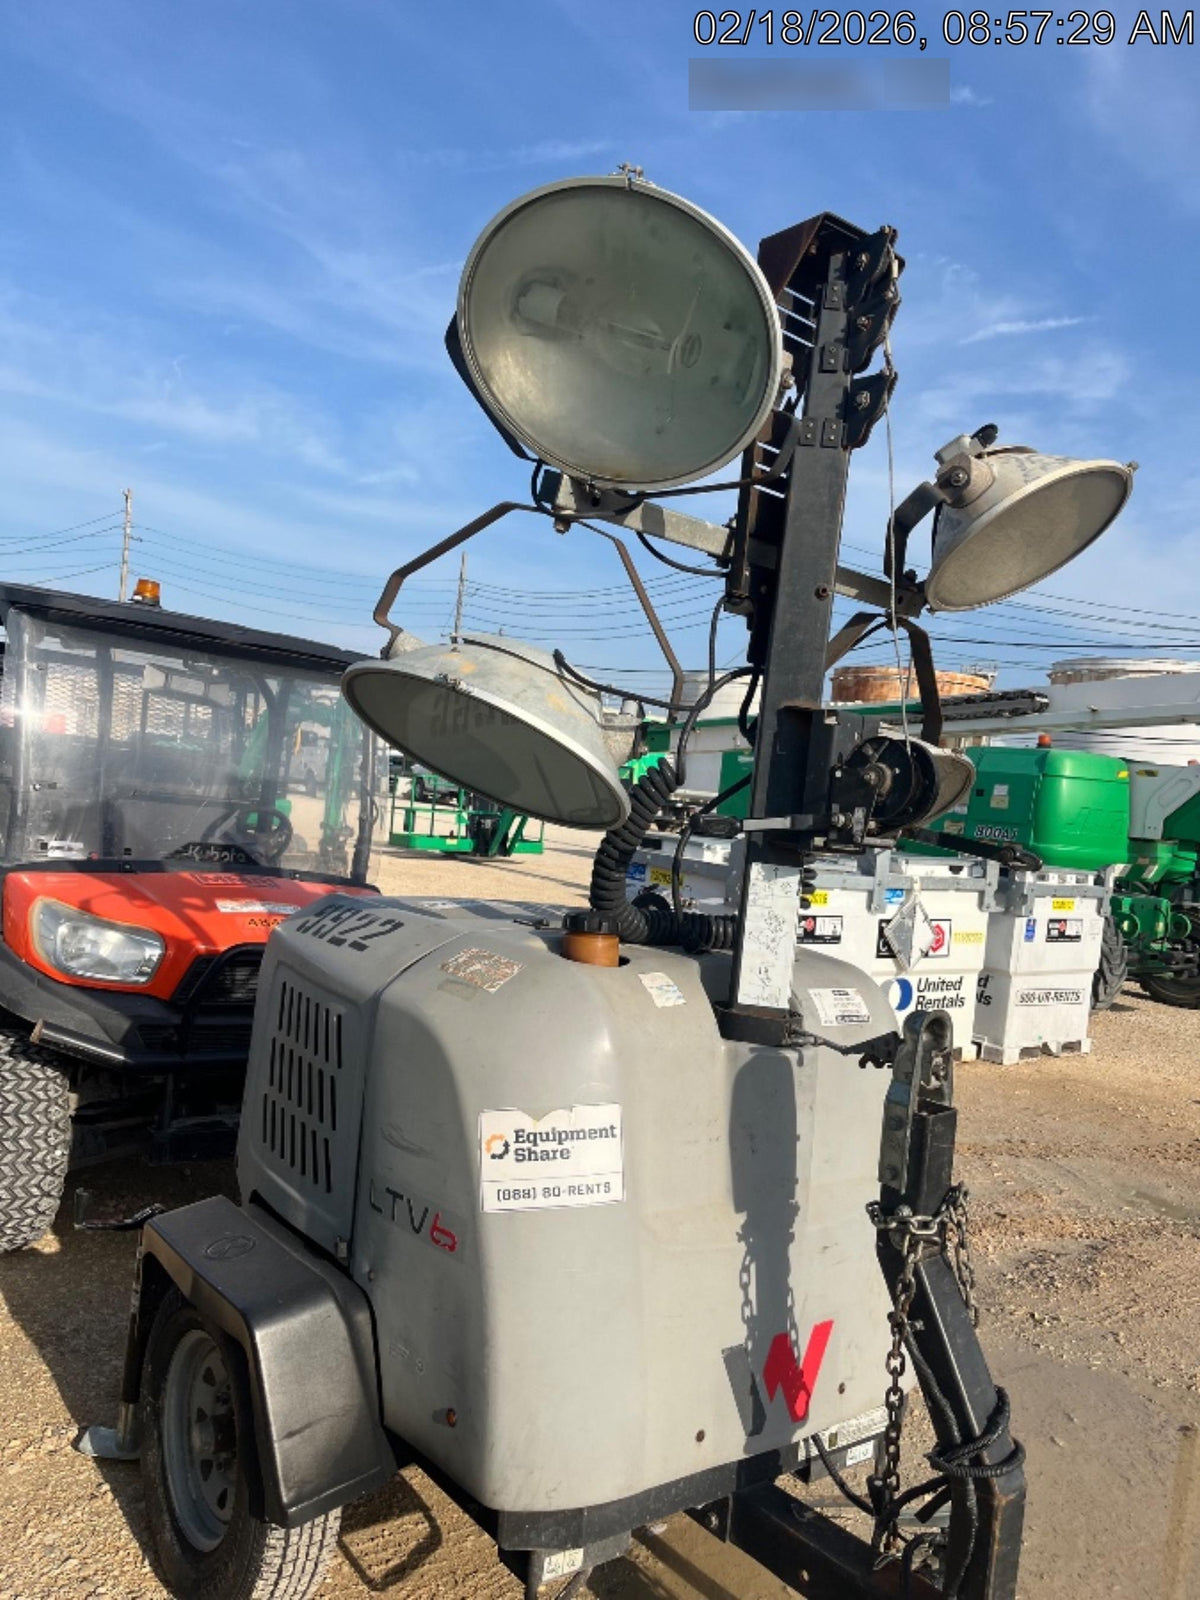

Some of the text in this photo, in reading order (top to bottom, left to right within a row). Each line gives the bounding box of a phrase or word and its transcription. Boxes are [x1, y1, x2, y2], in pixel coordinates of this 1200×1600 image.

[917, 976, 964, 993] United
[915, 994, 965, 1011] Rentals
[513, 1124, 617, 1147] Equipment
[513, 1147, 571, 1163] Share
